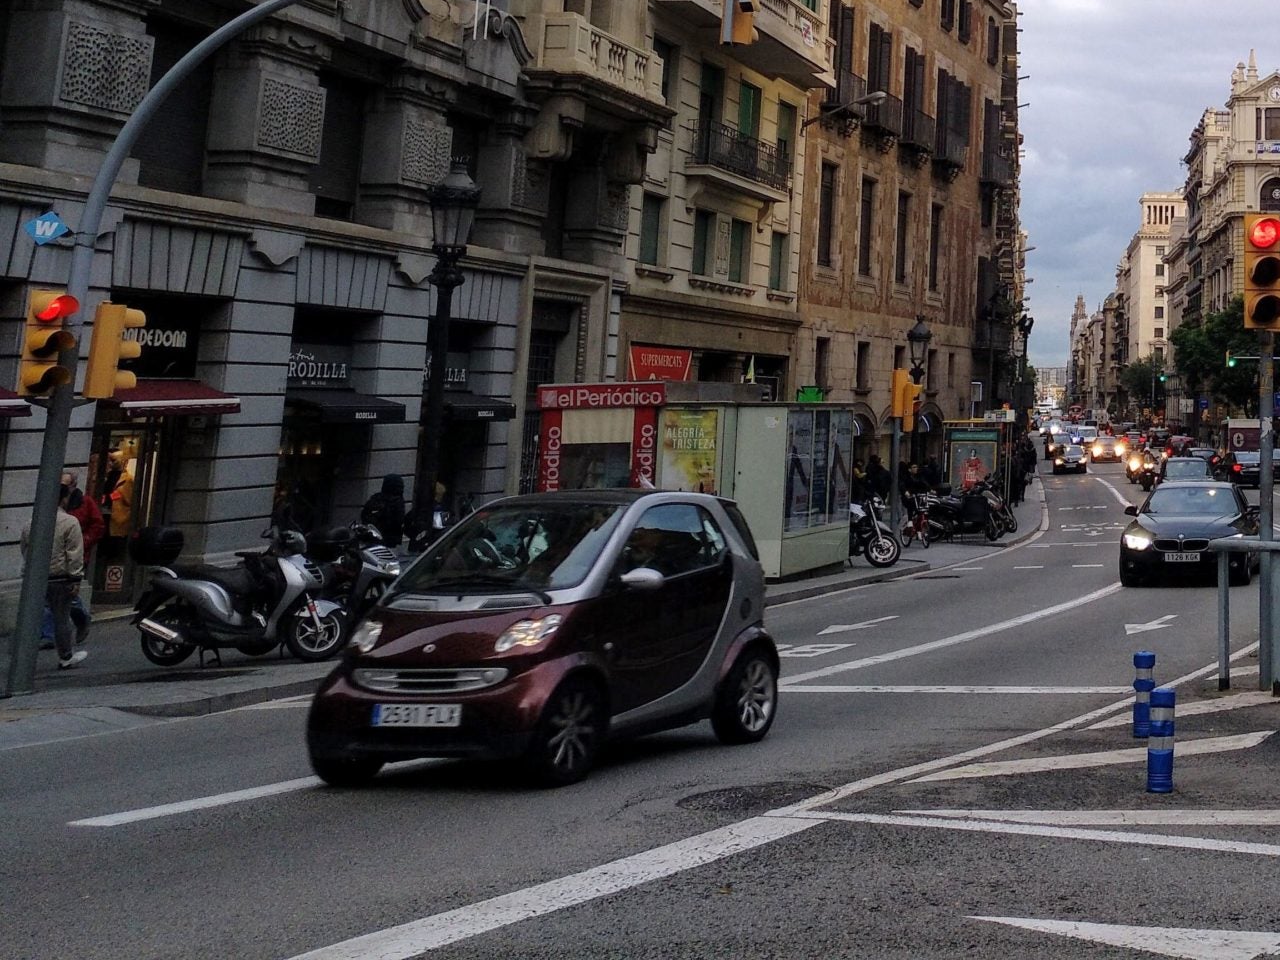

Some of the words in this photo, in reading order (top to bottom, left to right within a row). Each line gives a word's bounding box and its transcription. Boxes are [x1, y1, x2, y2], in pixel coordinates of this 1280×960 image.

[35, 220, 59, 237] W
[640, 353, 683, 368] SUPERMERCATS
[288, 361, 347, 378] RODILLA
[558, 390, 574, 407] el
[576, 387, 662, 407] Periódico
[666, 425, 705, 438] ALEGRÍA
[672, 438, 716, 449] TRISTEZA
[542, 426, 561, 492] riódico
[383, 707, 419, 724] 2531
